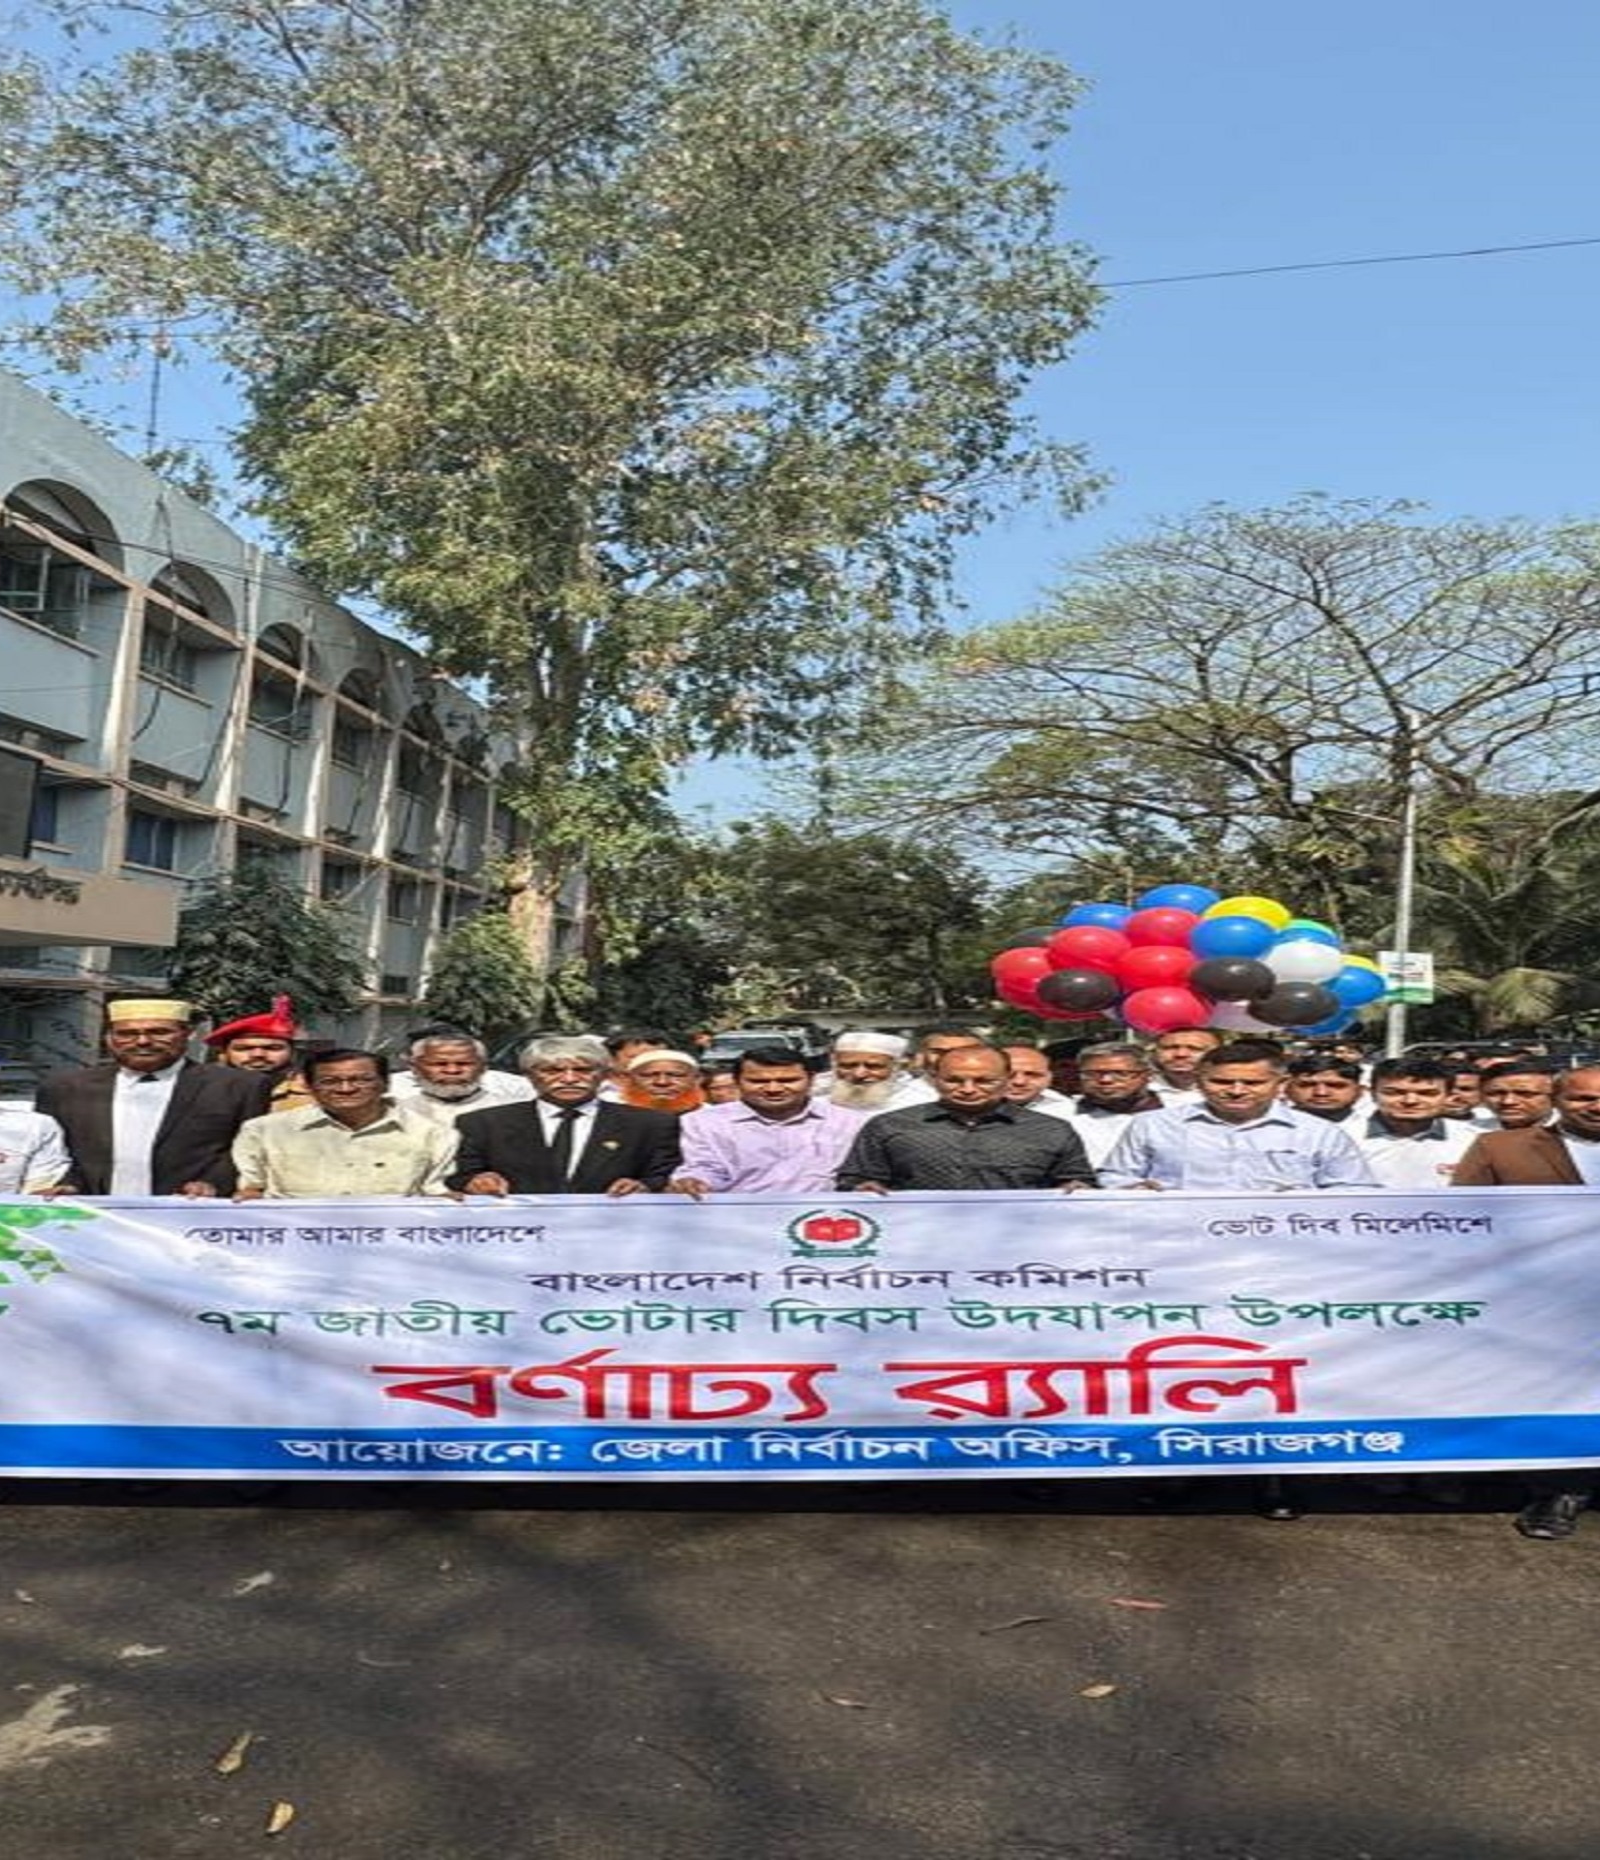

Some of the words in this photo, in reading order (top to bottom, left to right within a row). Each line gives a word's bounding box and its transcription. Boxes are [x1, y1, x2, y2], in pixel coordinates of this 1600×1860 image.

[186, 1226, 285, 1245] তোমার
[298, 1226, 386, 1245] আমার
[398, 1225, 546, 1246] বাংলাদেশে
[1208, 1215, 1276, 1237] ভোট
[1288, 1212, 1340, 1236] দিব
[1351, 1211, 1492, 1236] মিলেমিশে
[526, 1271, 758, 1293] বাংলাদেশ
[782, 1264, 952, 1291] নির্বাচন
[970, 1263, 1153, 1289] কমিশন
[197, 1310, 291, 1335] ৭ম
[307, 1299, 516, 1337] জাতীয়
[540, 1300, 744, 1334] ভোটার
[763, 1299, 926, 1334] দিবস
[946, 1299, 1207, 1332] উদযাপন
[1228, 1294, 1487, 1328] উপলক্ষে
[370, 1348, 838, 1422] বর্ণাঢ্য
[592, 1435, 731, 1462] জেলা
[746, 1431, 938, 1461] নির্বাচন
[950, 1428, 1133, 1465] অফিস,
[1154, 1426, 1404, 1460] সিরাজগঞ্জ
